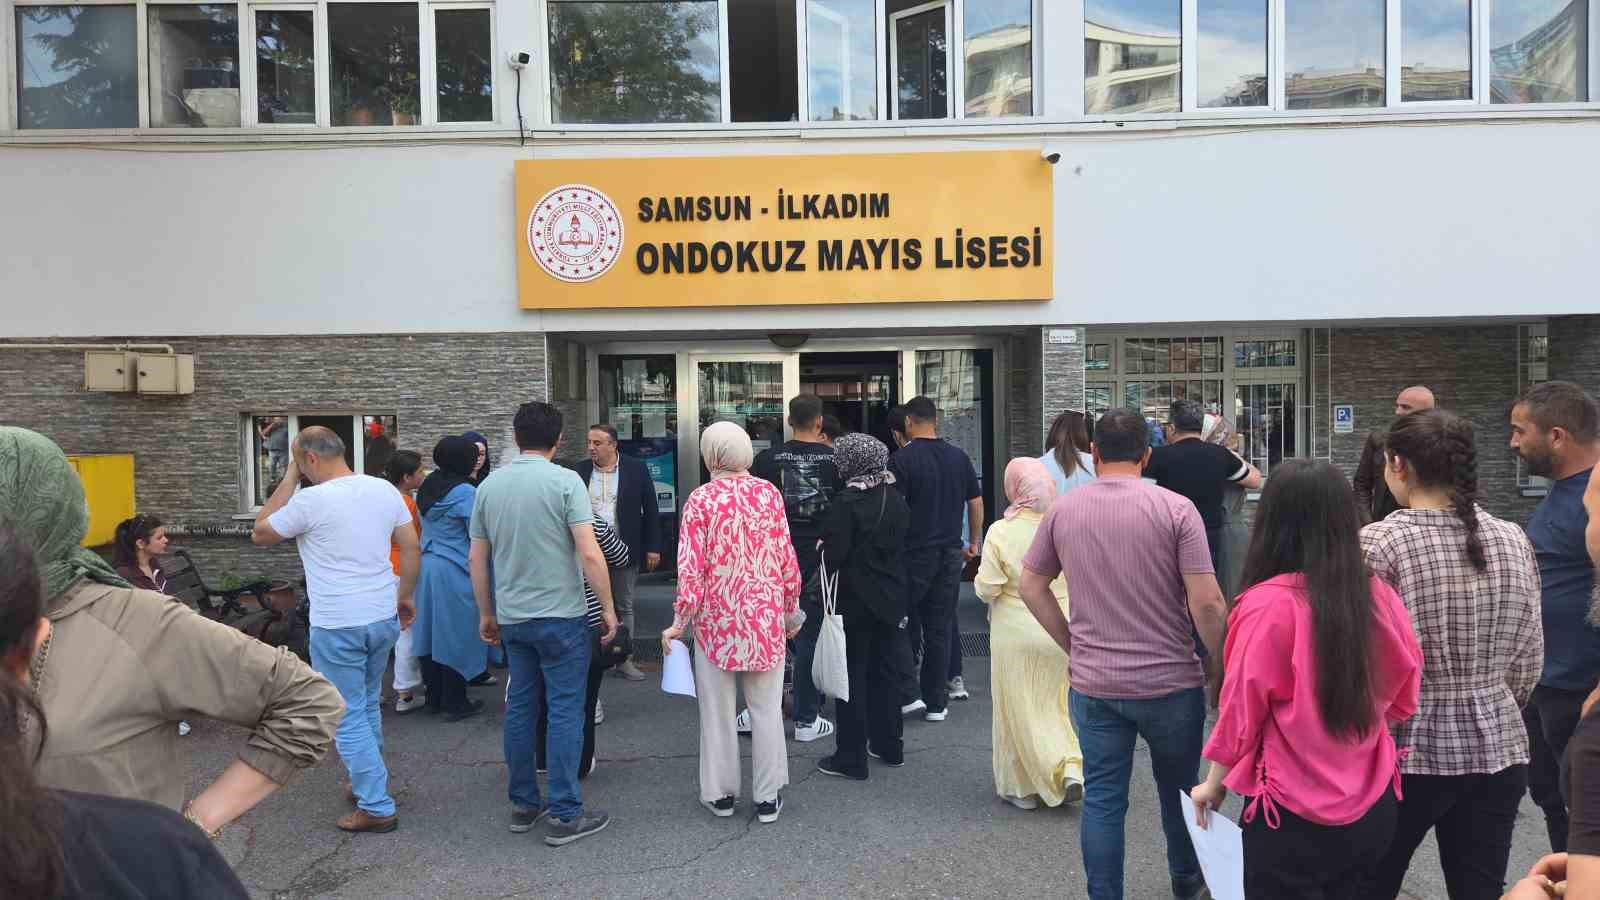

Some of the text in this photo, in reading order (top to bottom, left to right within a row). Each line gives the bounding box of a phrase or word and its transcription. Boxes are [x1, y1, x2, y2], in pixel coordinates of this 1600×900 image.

[638, 195, 751, 222] SAMSUN
[778, 188, 890, 220] İLKADIM
[636, 227, 1041, 275] ONDOKUZ MAYIS LİSESİ
